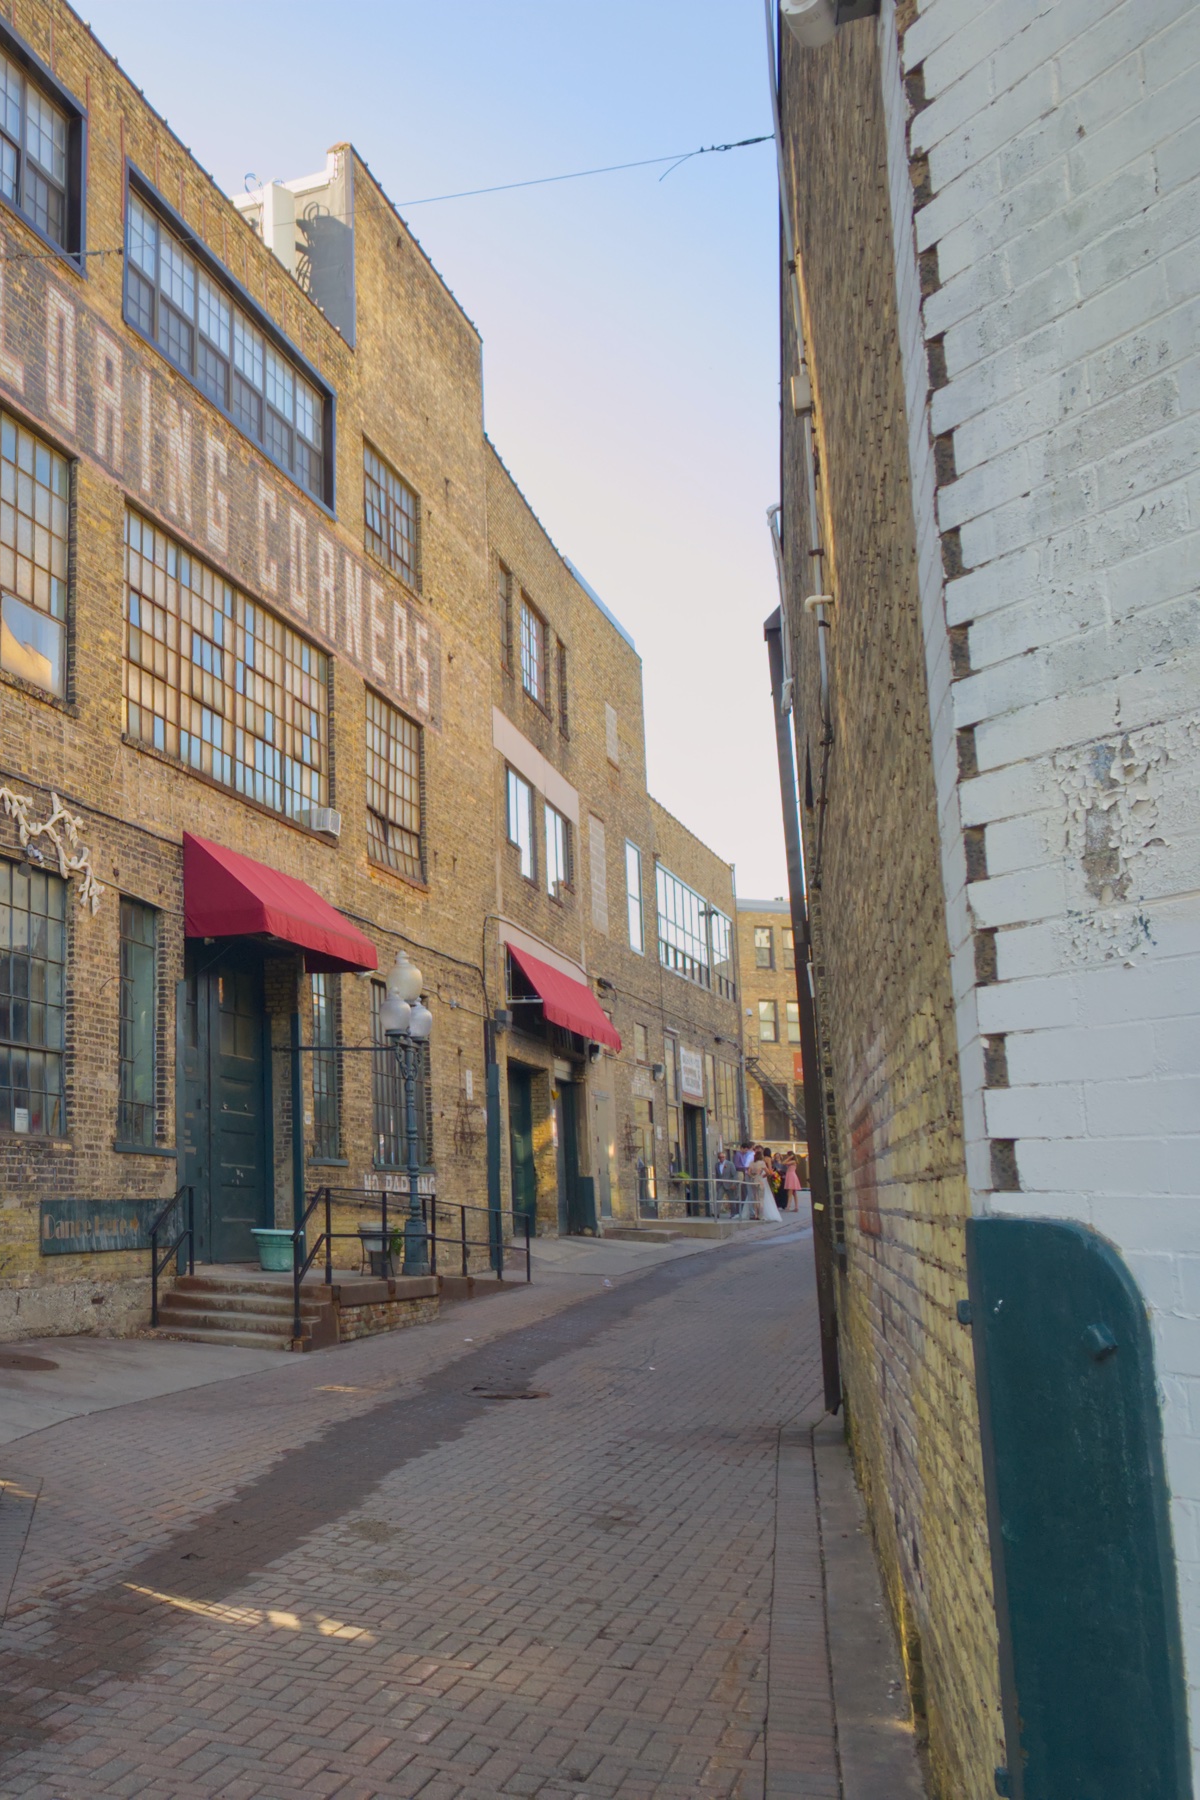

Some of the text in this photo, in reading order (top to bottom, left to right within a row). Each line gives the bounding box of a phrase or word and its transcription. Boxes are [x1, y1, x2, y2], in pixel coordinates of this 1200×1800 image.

[257, 477, 431, 714] CORNERS
[364, 1174, 436, 1198] NO PARING
[42, 1213, 92, 1240] Dance
